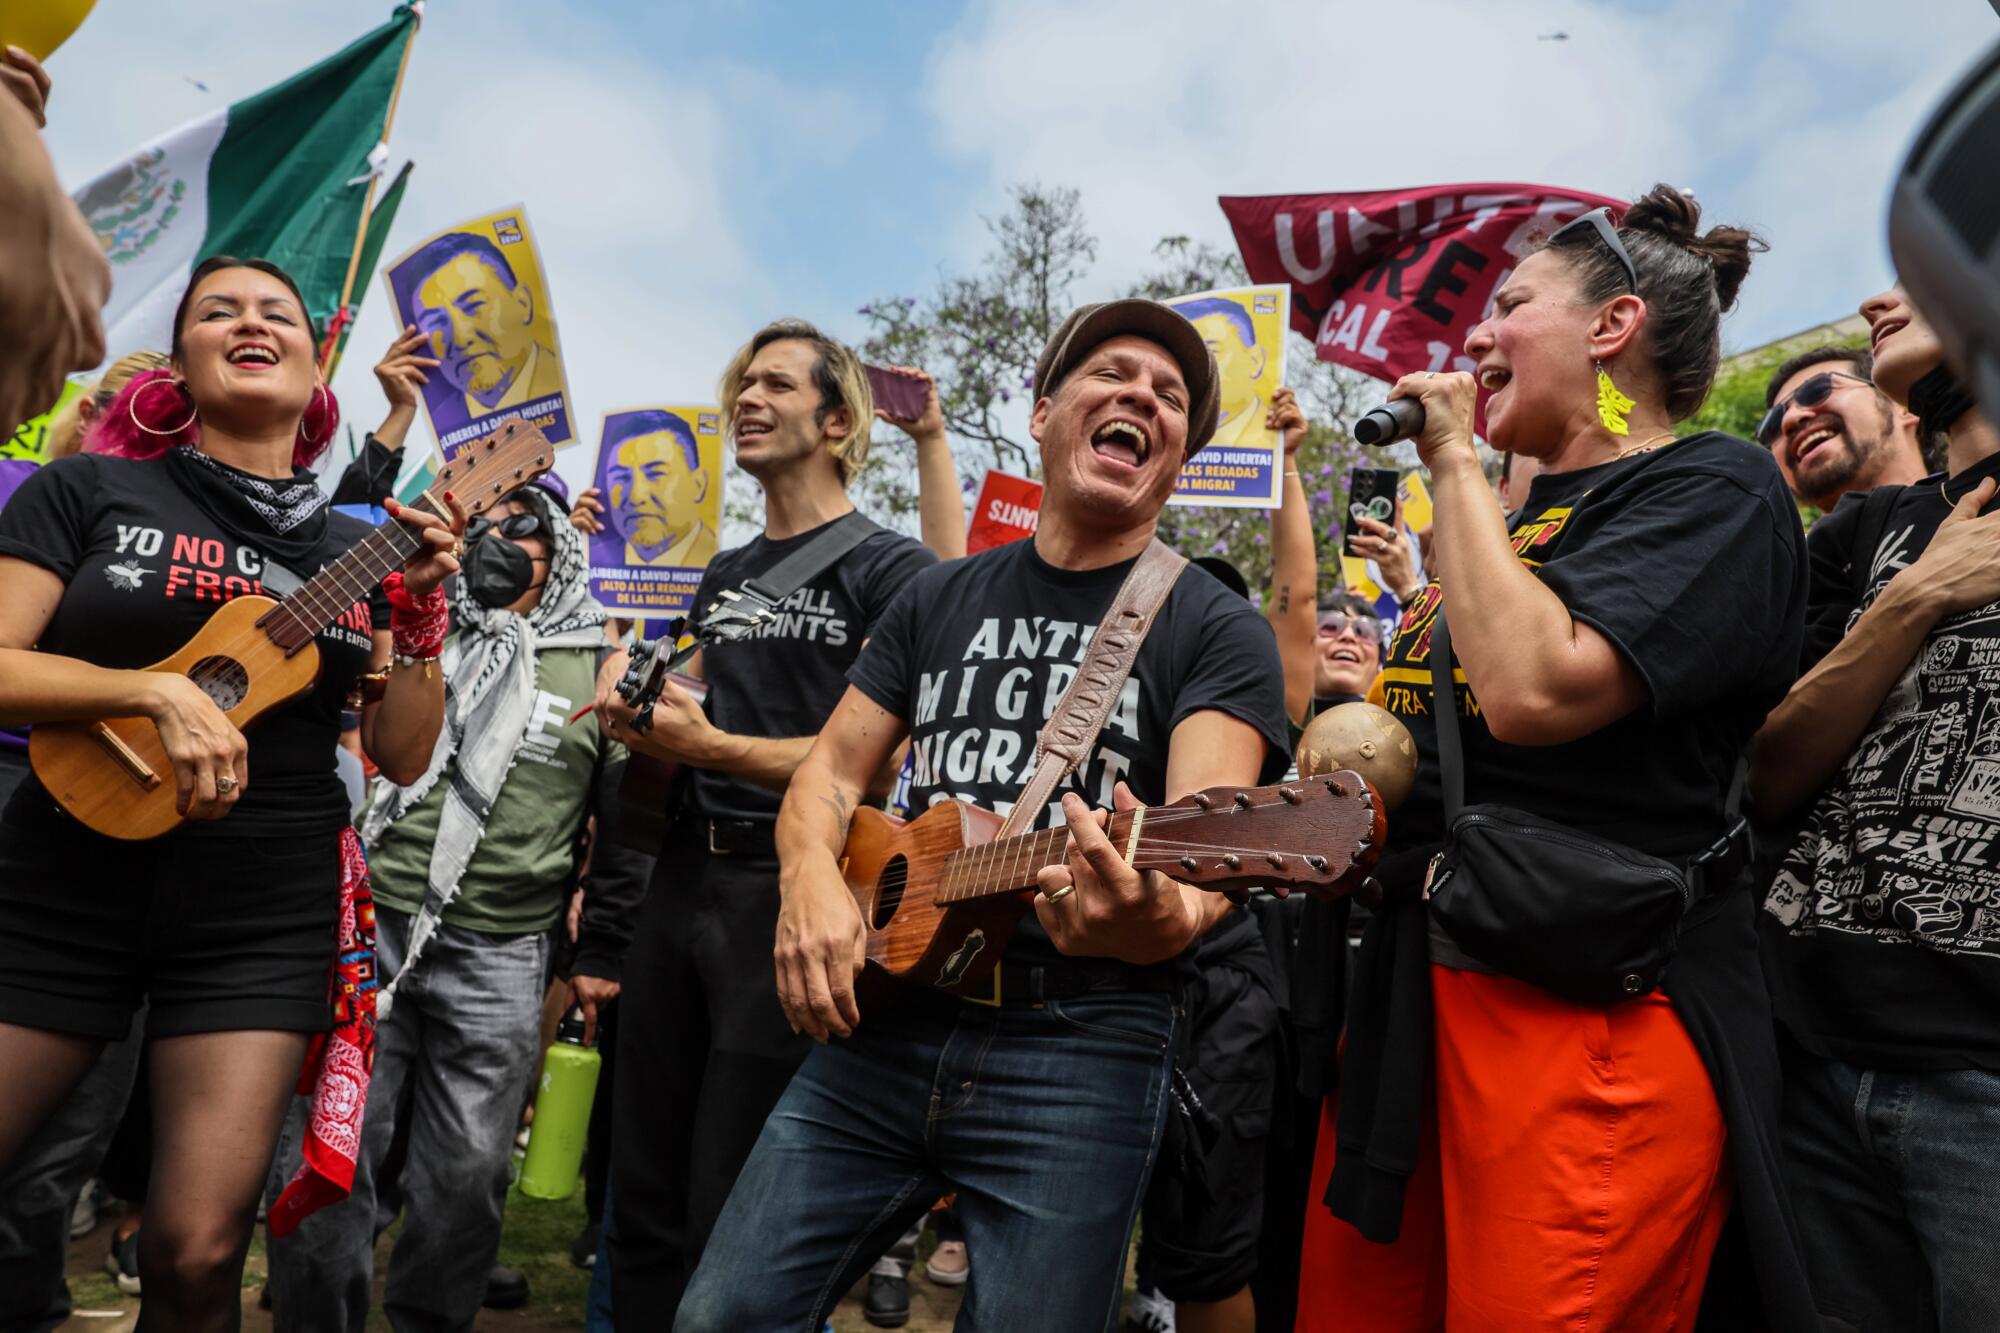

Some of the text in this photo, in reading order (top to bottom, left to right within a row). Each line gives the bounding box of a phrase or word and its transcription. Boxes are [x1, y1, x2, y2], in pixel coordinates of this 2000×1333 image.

[1318, 300, 1392, 362] CAL
[440, 424, 481, 450] ¡LIBEREN
[481, 421, 490, 433] A
[521, 398, 563, 418] HUERTA!
[1190, 452, 1272, 466] AVID HUERTA!
[1205, 466, 1259, 479] REDADAS
[1191, 478, 1236, 491] MIGRA!
[115, 524, 164, 557] YO
[172, 534, 224, 568] NO
[632, 570, 639, 580] A
[640, 570, 670, 581] DAVID
[672, 571, 704, 583] HUERT
[600, 580, 699, 595] ¡ALTO A LAS REDADA
[617, 593, 683, 606] DE LA MIGRA!
[784, 587, 835, 616] ALL
[323, 626, 344, 641] LAS
[1889, 830, 1994, 866] EXIL
